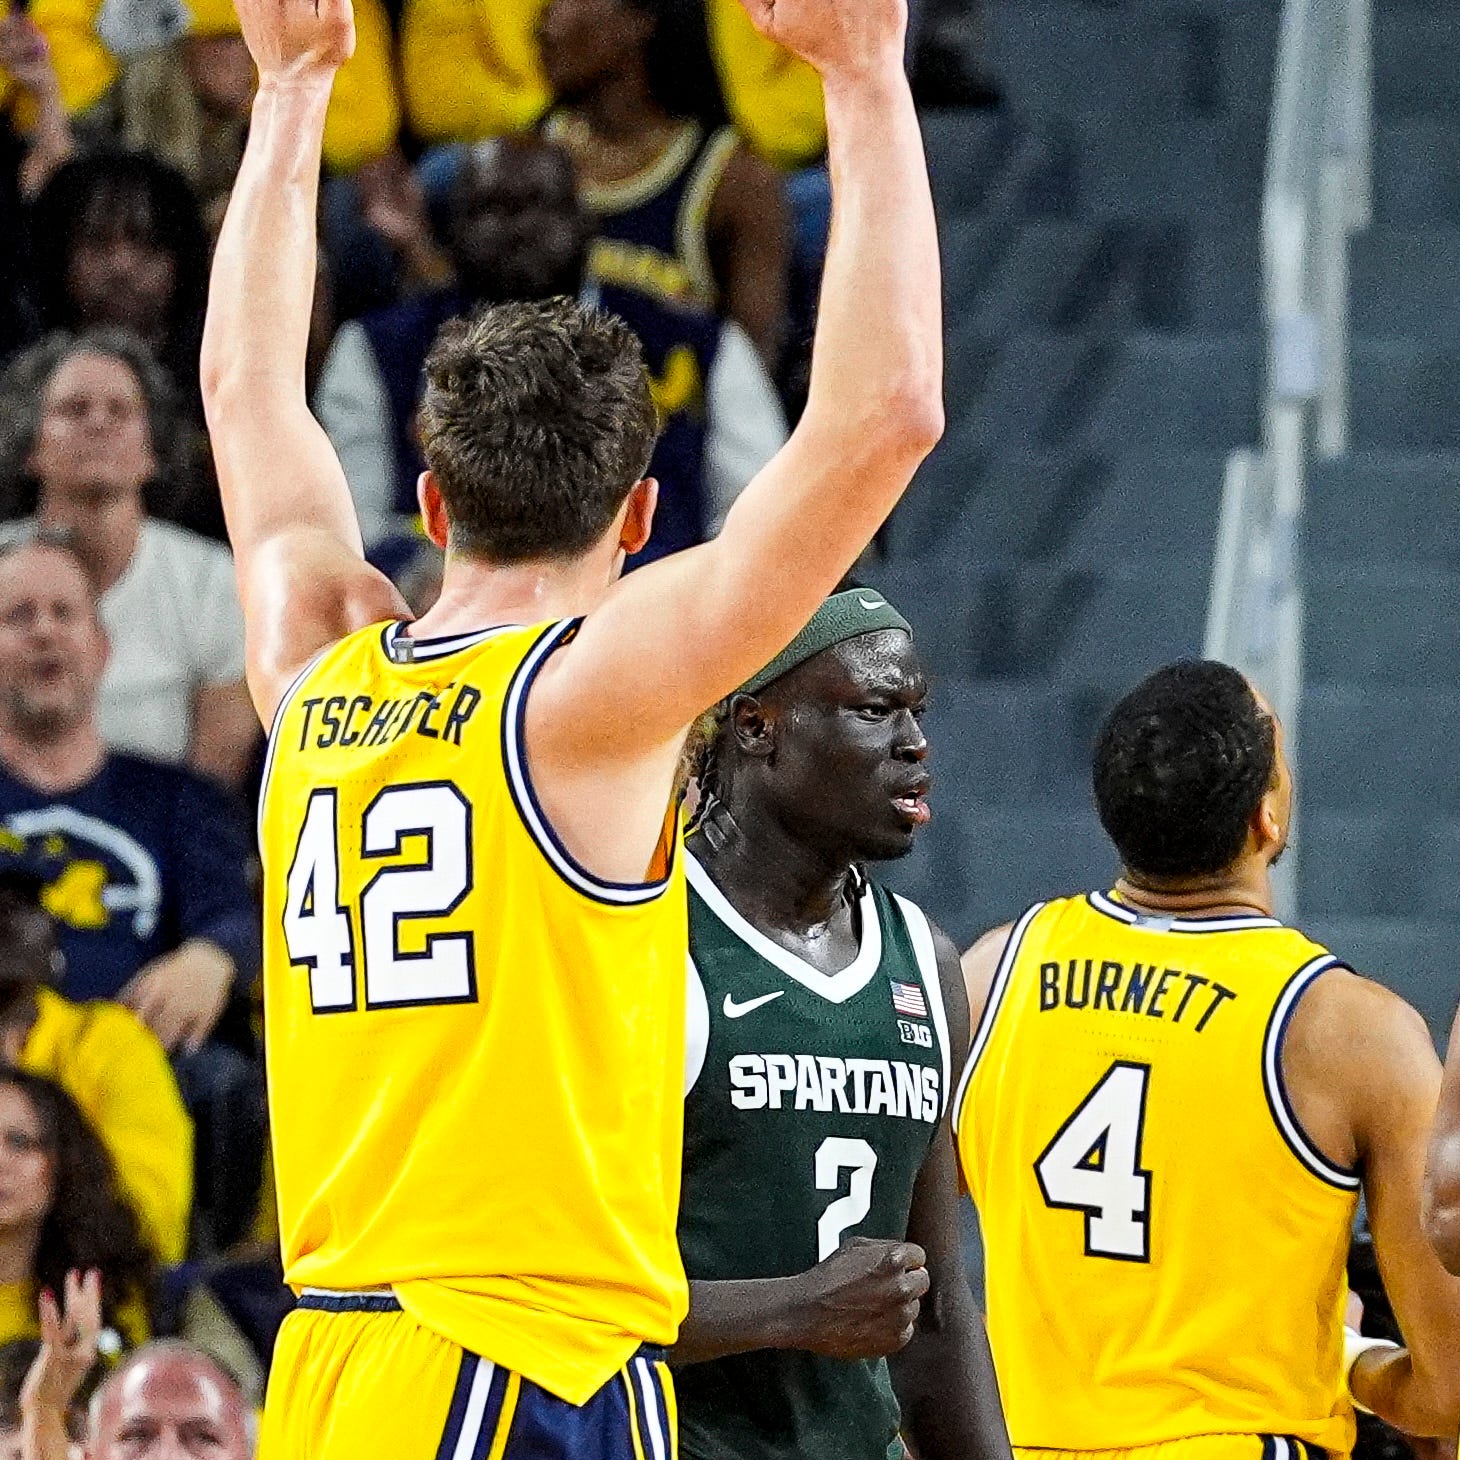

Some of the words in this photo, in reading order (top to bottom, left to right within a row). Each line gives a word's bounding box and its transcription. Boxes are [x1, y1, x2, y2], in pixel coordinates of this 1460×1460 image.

[281, 778, 479, 1016] 42
[1039, 960, 1237, 1034] BURNETT
[728, 1054, 941, 1125] SPARTANS
[813, 1136, 878, 1264] 2
[1033, 1059, 1153, 1264] 4
